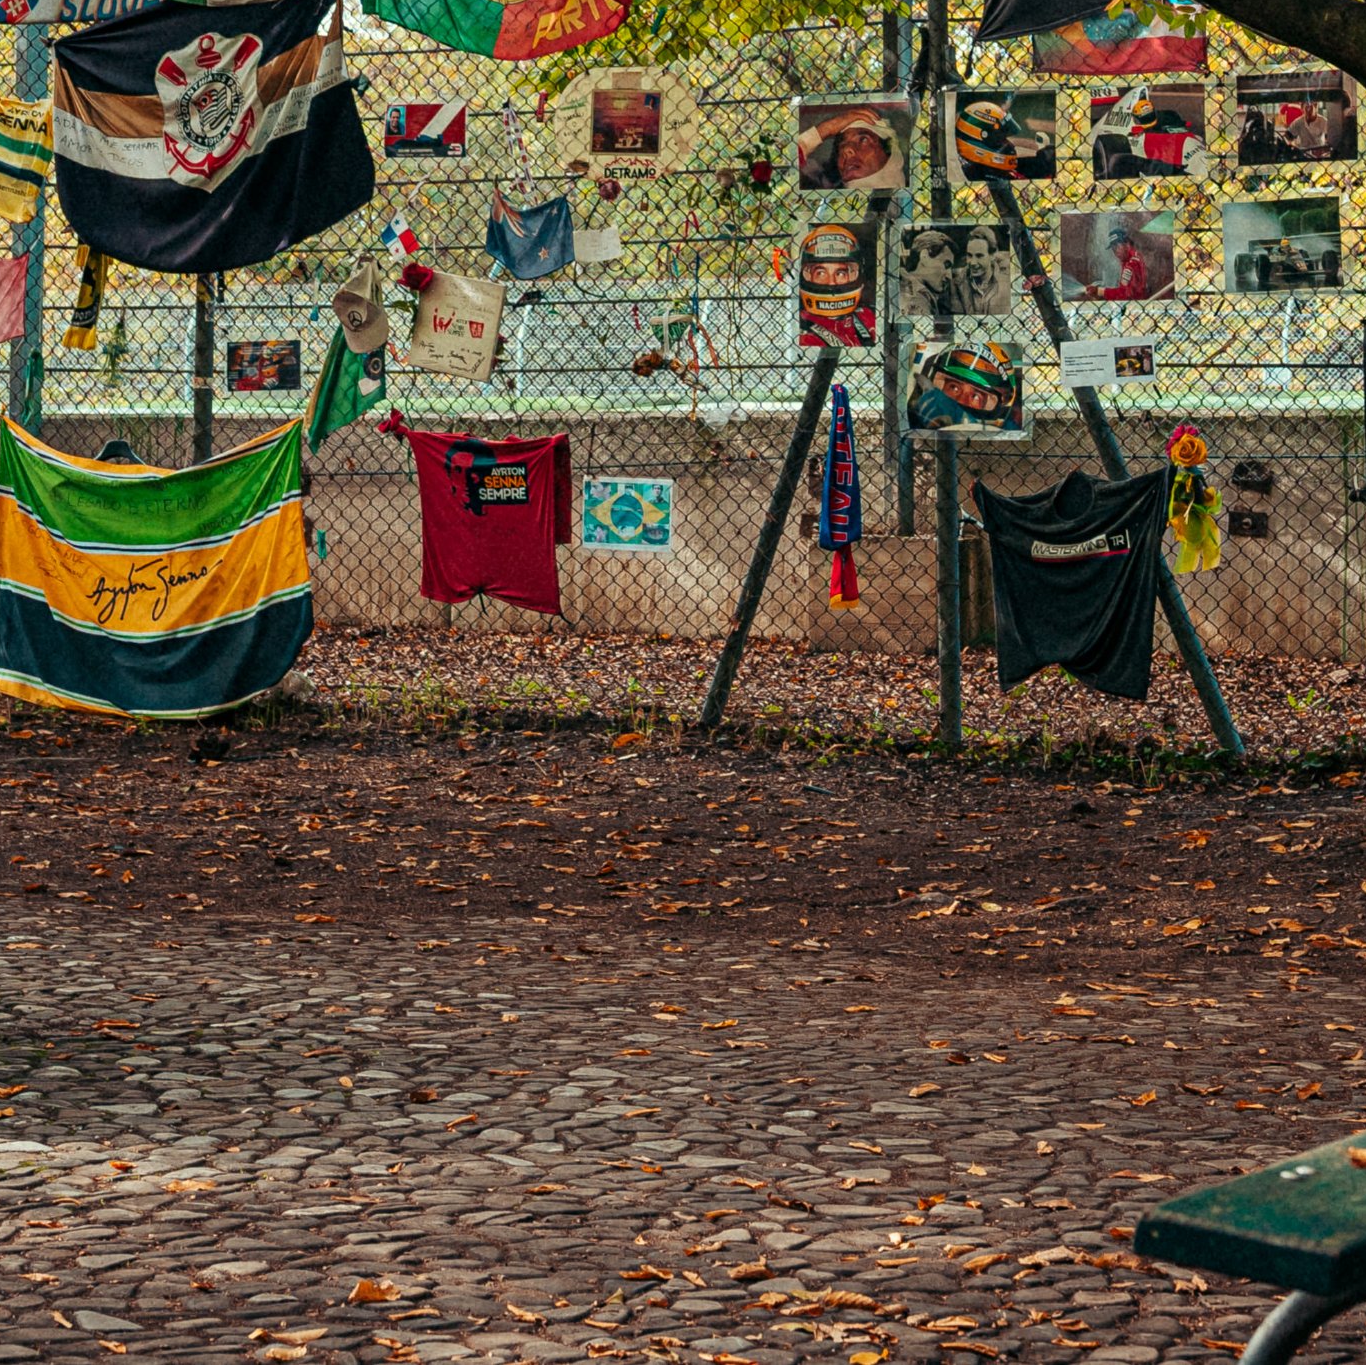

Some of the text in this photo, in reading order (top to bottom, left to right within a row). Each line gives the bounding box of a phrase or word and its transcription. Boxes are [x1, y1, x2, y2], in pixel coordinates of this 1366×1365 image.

[818, 300, 854, 310] NACIONAL
[491, 467, 526, 476] AYRTON
[484, 475, 527, 488] SENNA
[478, 487, 527, 501] SEMPRE
[1109, 534, 1125, 547] TR
